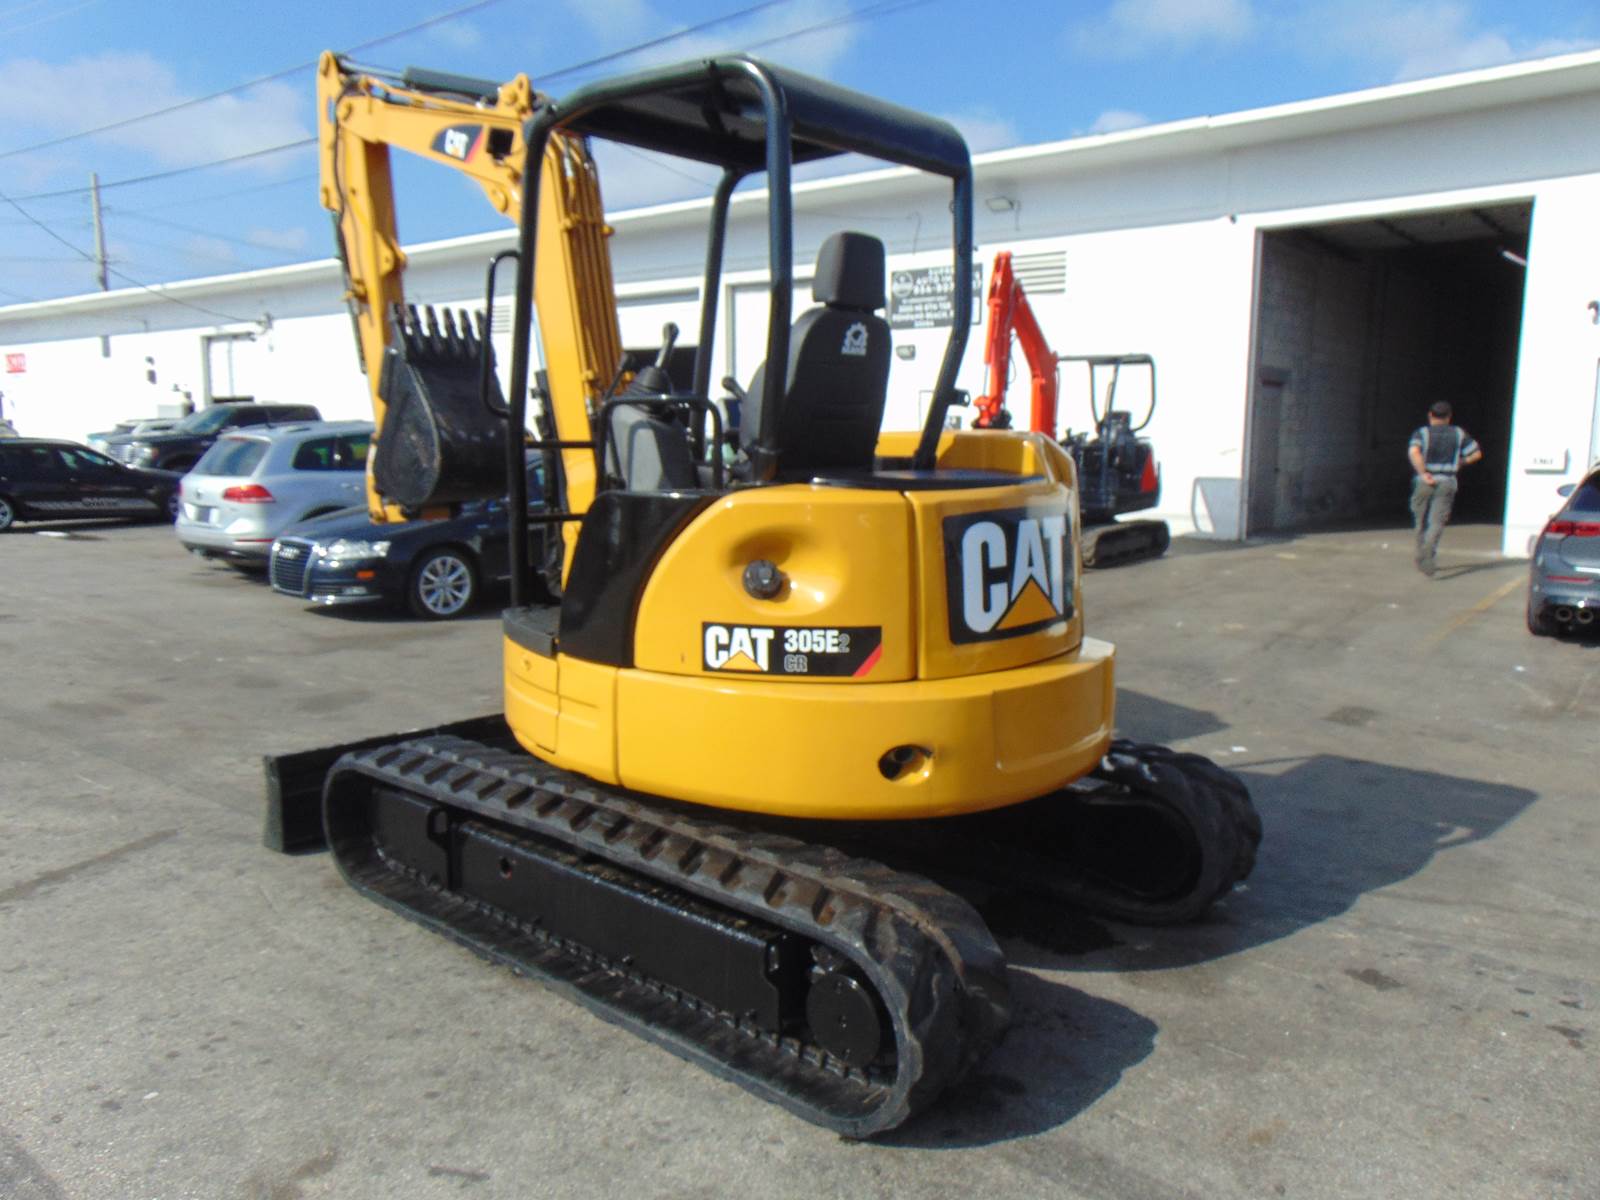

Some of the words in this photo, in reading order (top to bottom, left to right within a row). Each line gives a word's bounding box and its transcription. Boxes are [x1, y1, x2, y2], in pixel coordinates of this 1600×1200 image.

[962, 515, 1067, 634] CAT
[704, 625, 775, 671] CAT
[784, 654, 808, 672] CR
